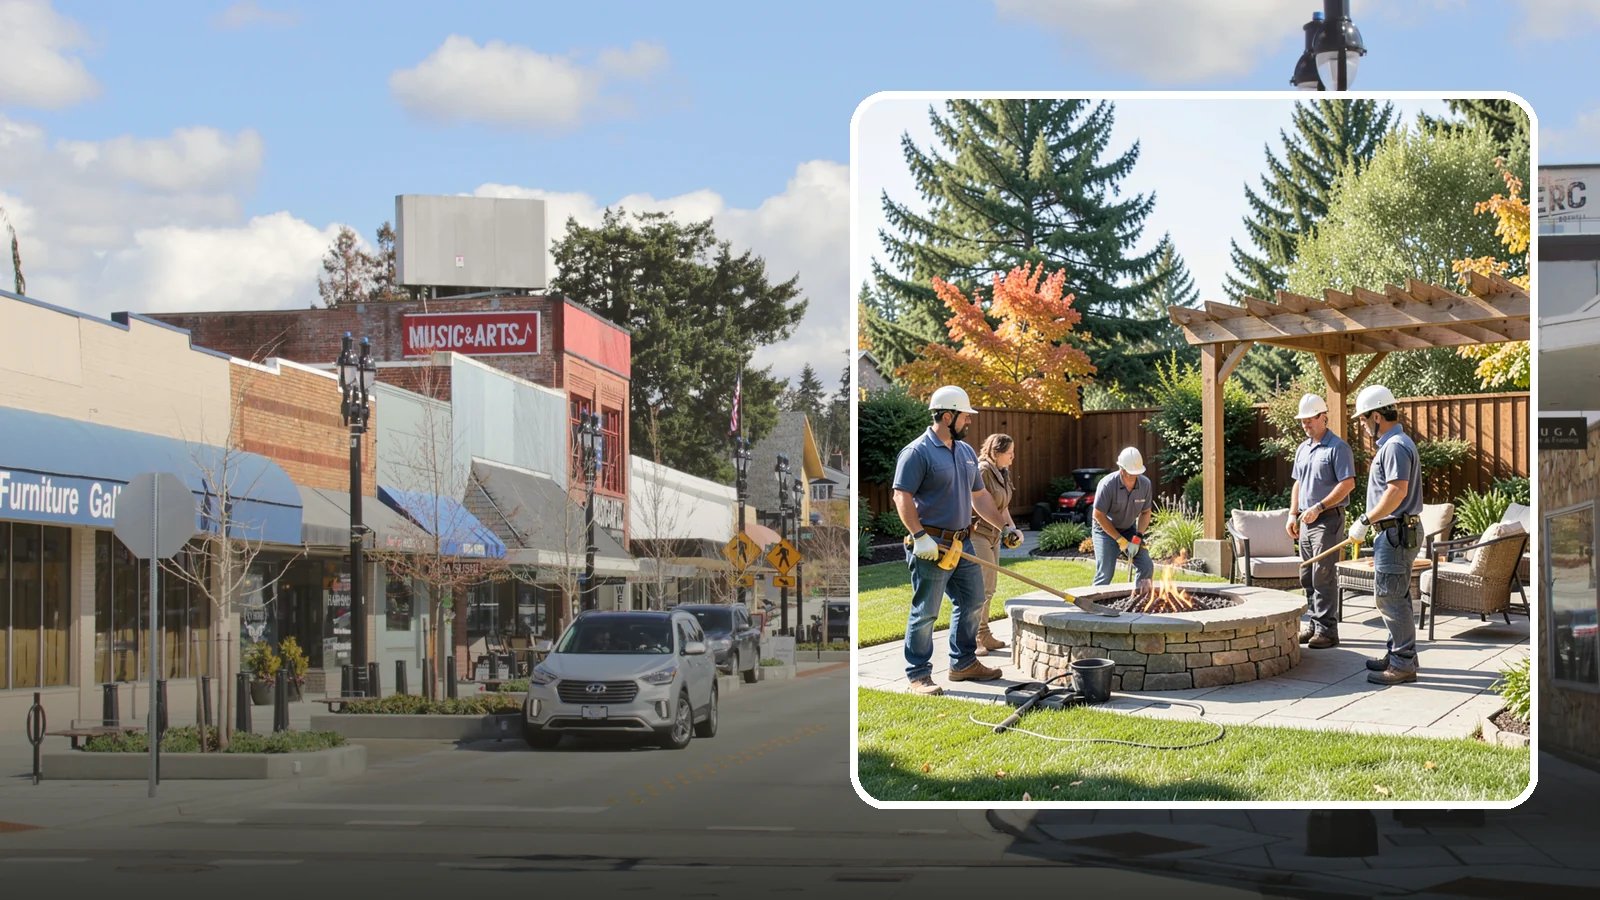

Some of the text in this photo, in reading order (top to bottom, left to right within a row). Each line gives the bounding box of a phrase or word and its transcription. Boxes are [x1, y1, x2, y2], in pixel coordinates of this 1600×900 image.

[0, 471, 121, 519] Furniture Gal
[453, 563, 479, 574] SUSHI
